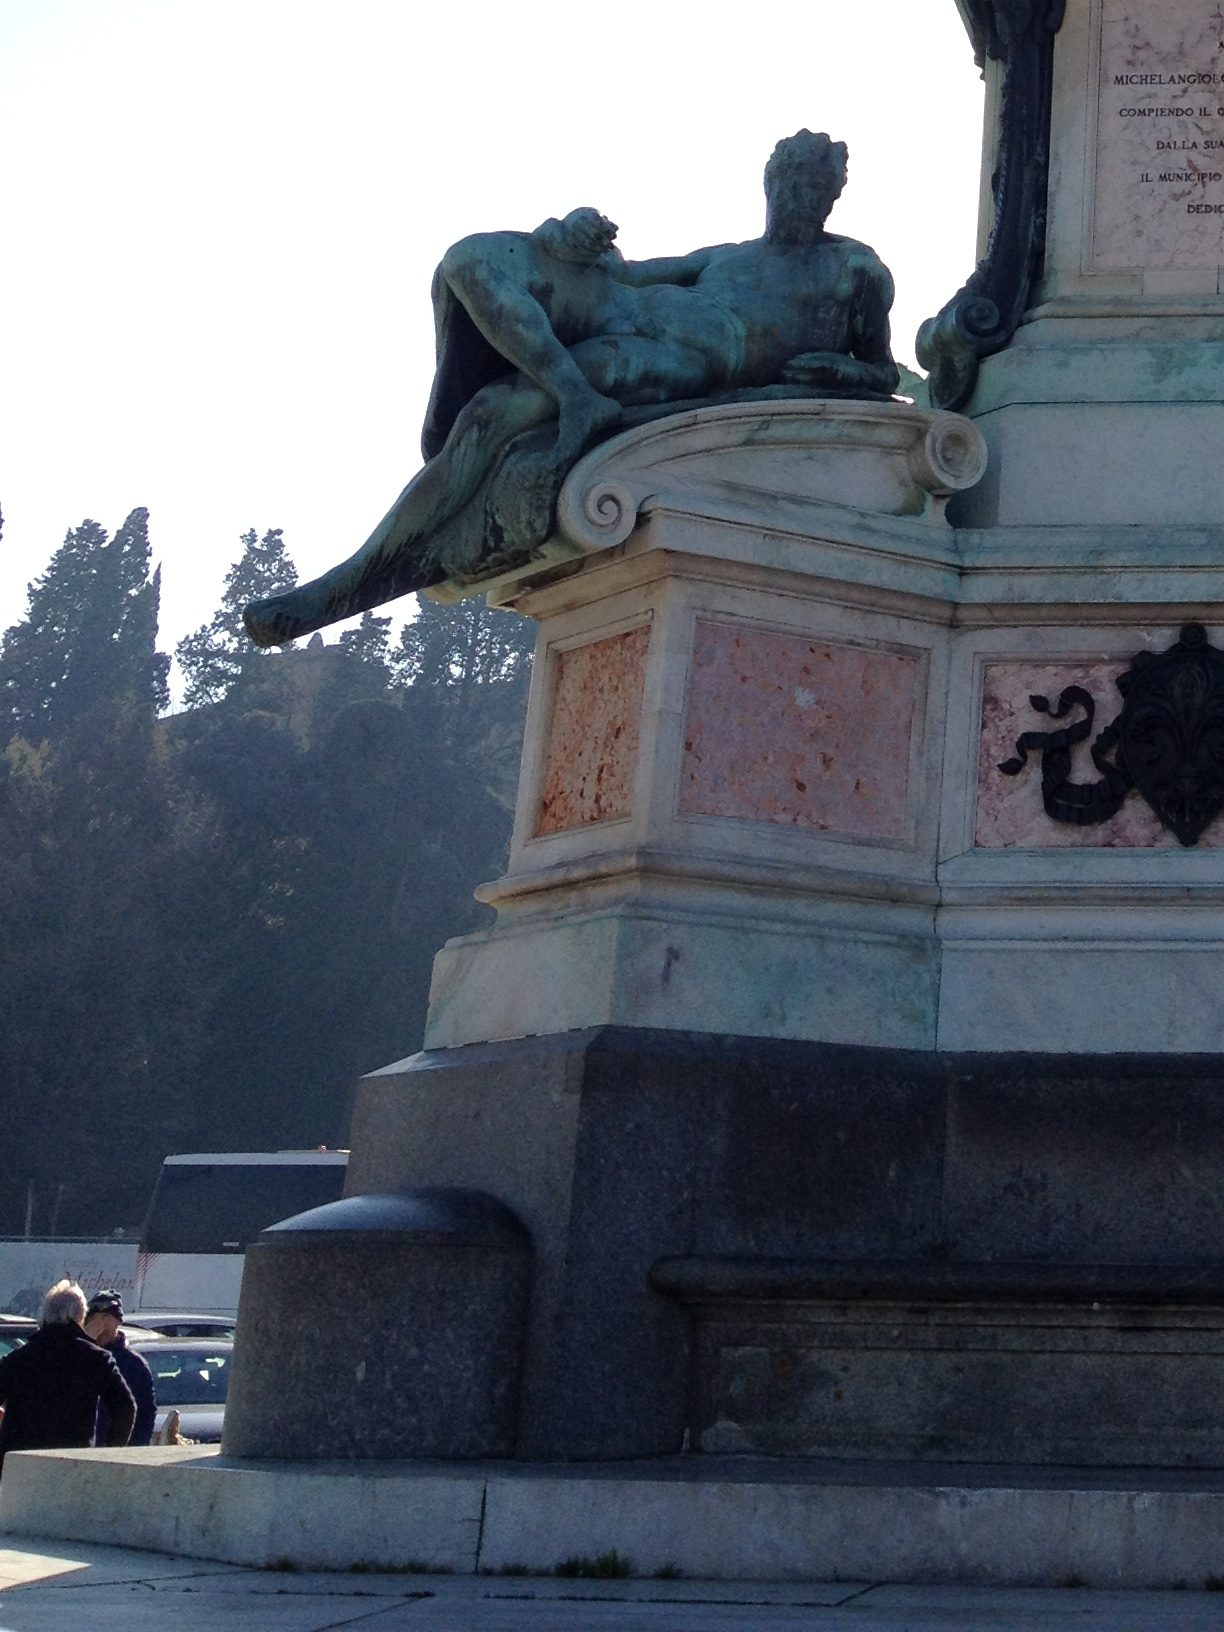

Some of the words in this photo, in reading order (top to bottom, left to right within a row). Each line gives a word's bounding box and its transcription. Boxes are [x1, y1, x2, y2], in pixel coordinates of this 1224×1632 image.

[1119, 107, 1195, 118] COMPIENDO
[1199, 107, 1212, 117] IL
[1156, 140, 1198, 151] DALLA
[1141, 173, 1153, 183] IL
[1158, 172, 1223, 183] MUNICIPIO
